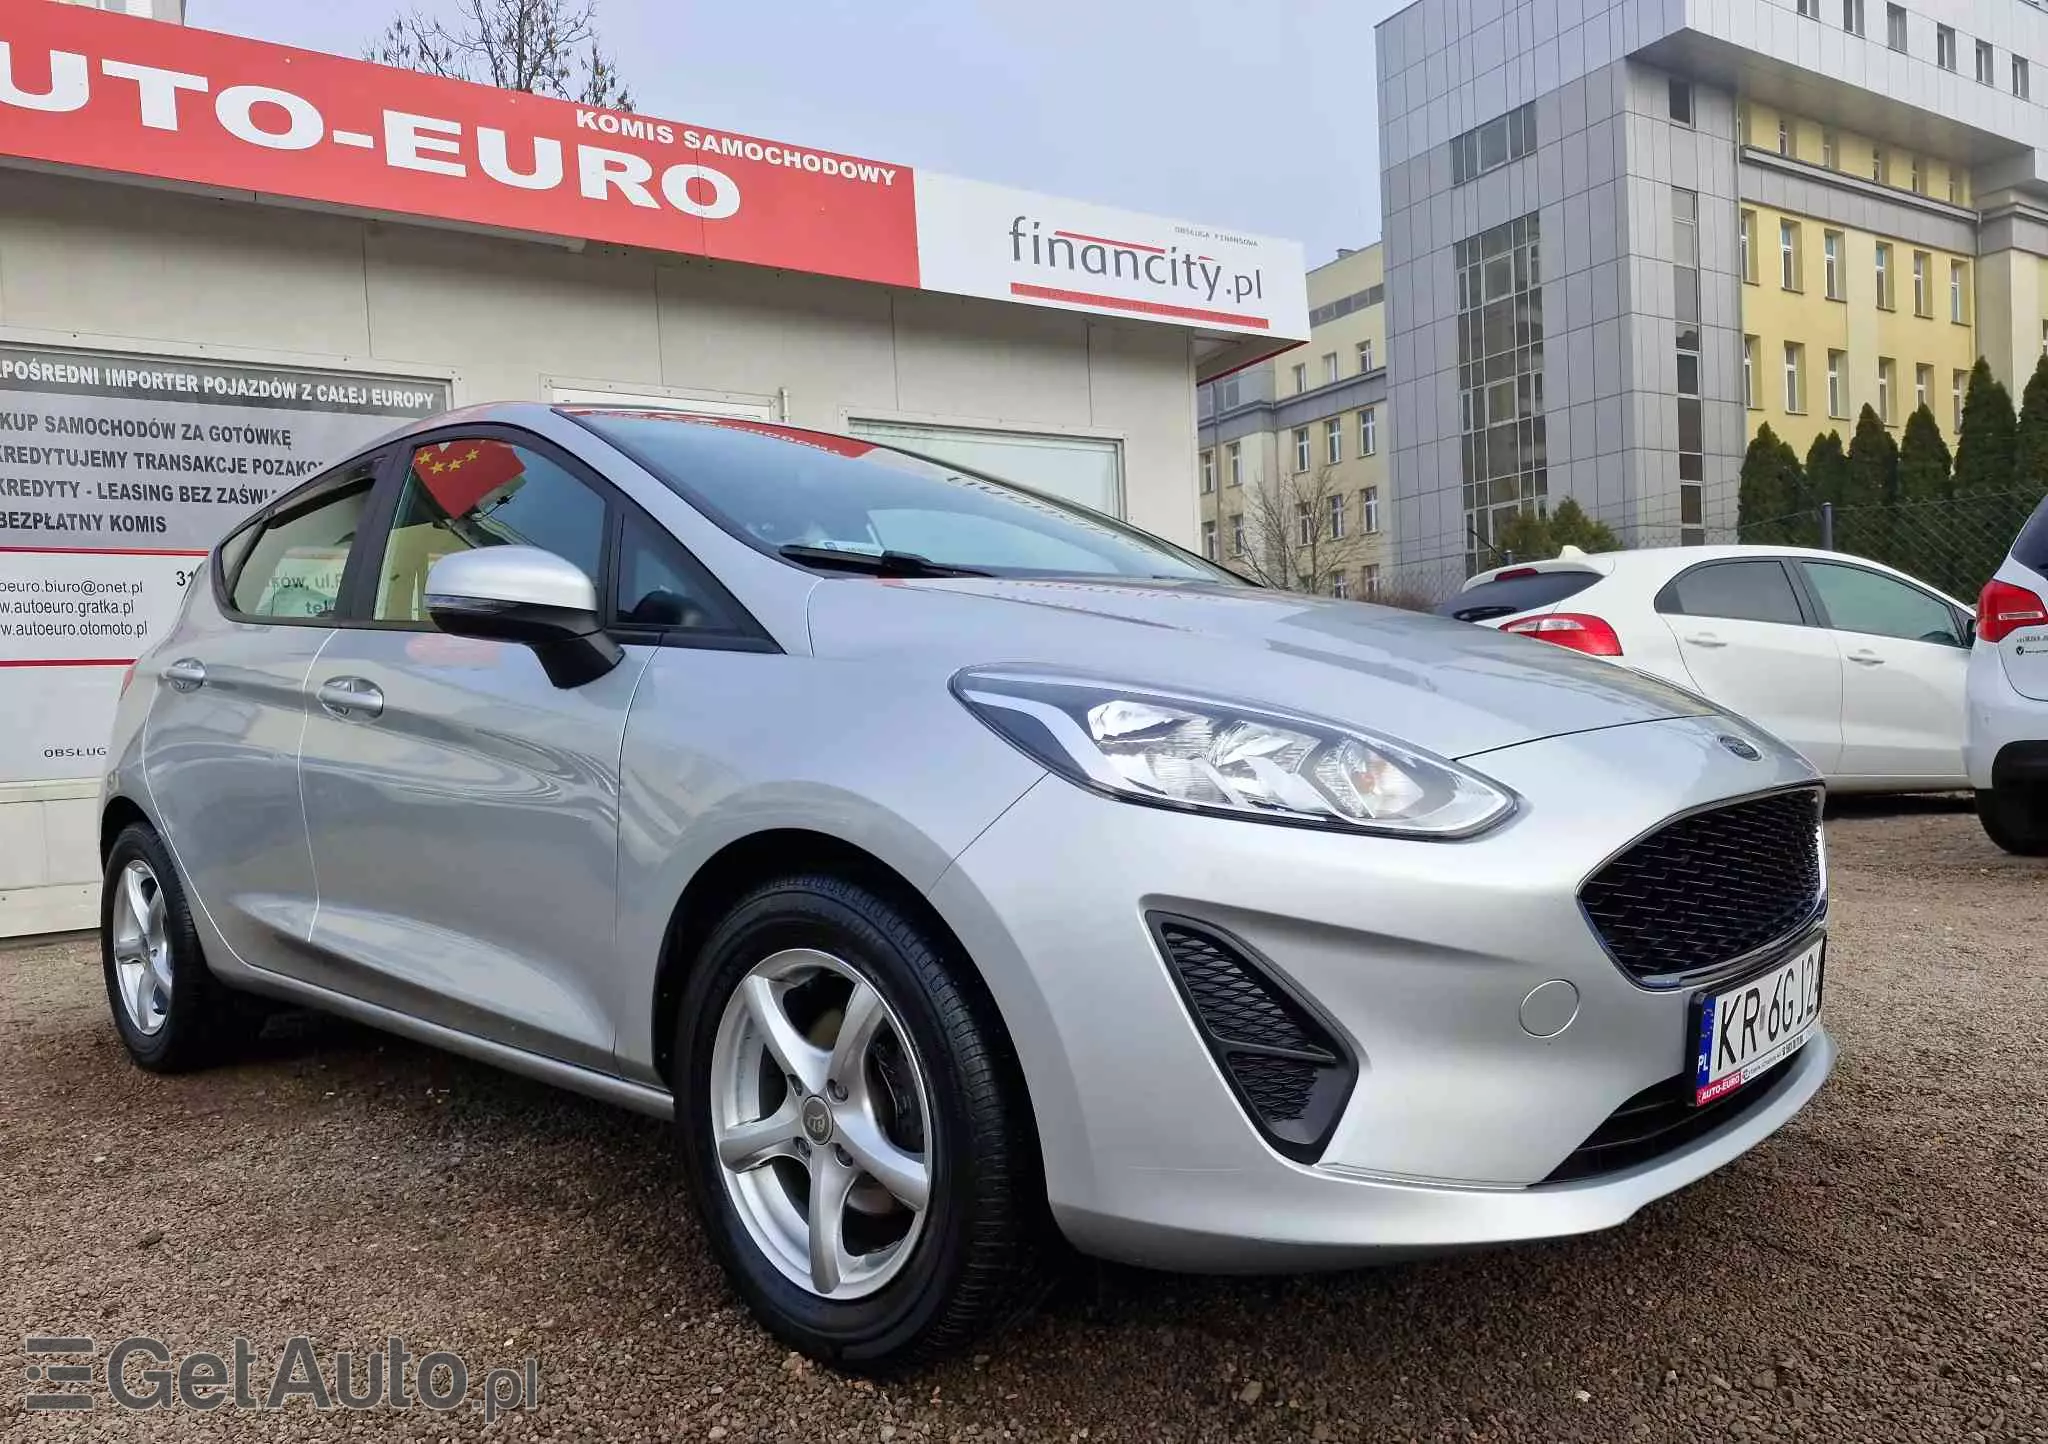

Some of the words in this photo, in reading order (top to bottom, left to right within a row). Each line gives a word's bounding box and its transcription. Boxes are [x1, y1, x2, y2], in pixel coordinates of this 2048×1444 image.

[575, 109, 674, 144] KOMIS
[683, 130, 896, 186] SAMOCHODOWY
[1008, 215, 1263, 303] financity.pl
[0, 358, 100, 385] POŚREDNI
[105, 368, 199, 393] IMPORTER
[203, 375, 297, 400] POJAZDÓW
[301, 383, 313, 401] Z
[316, 384, 367, 405] CAŁEJ
[371, 388, 434, 409] EUROPY
[0, 412, 39, 431] KUP
[44, 415, 176, 441] SAMOCHODÓW
[181, 423, 204, 441] ZA
[209, 424, 292, 451] GOTÓWKĘ
[133, 452, 248, 474] TRANSAKCJE
[252, 458, 323, 476] POZAKO
[97, 482, 174, 502] LEASING
[179, 486, 212, 503] BEZ
[109, 514, 167, 533] KOMIS
[1718, 987, 1761, 1072] KR
[1697, 1053, 1708, 1074] PL
[1701, 1074, 1740, 1104] AUTO-EURO
